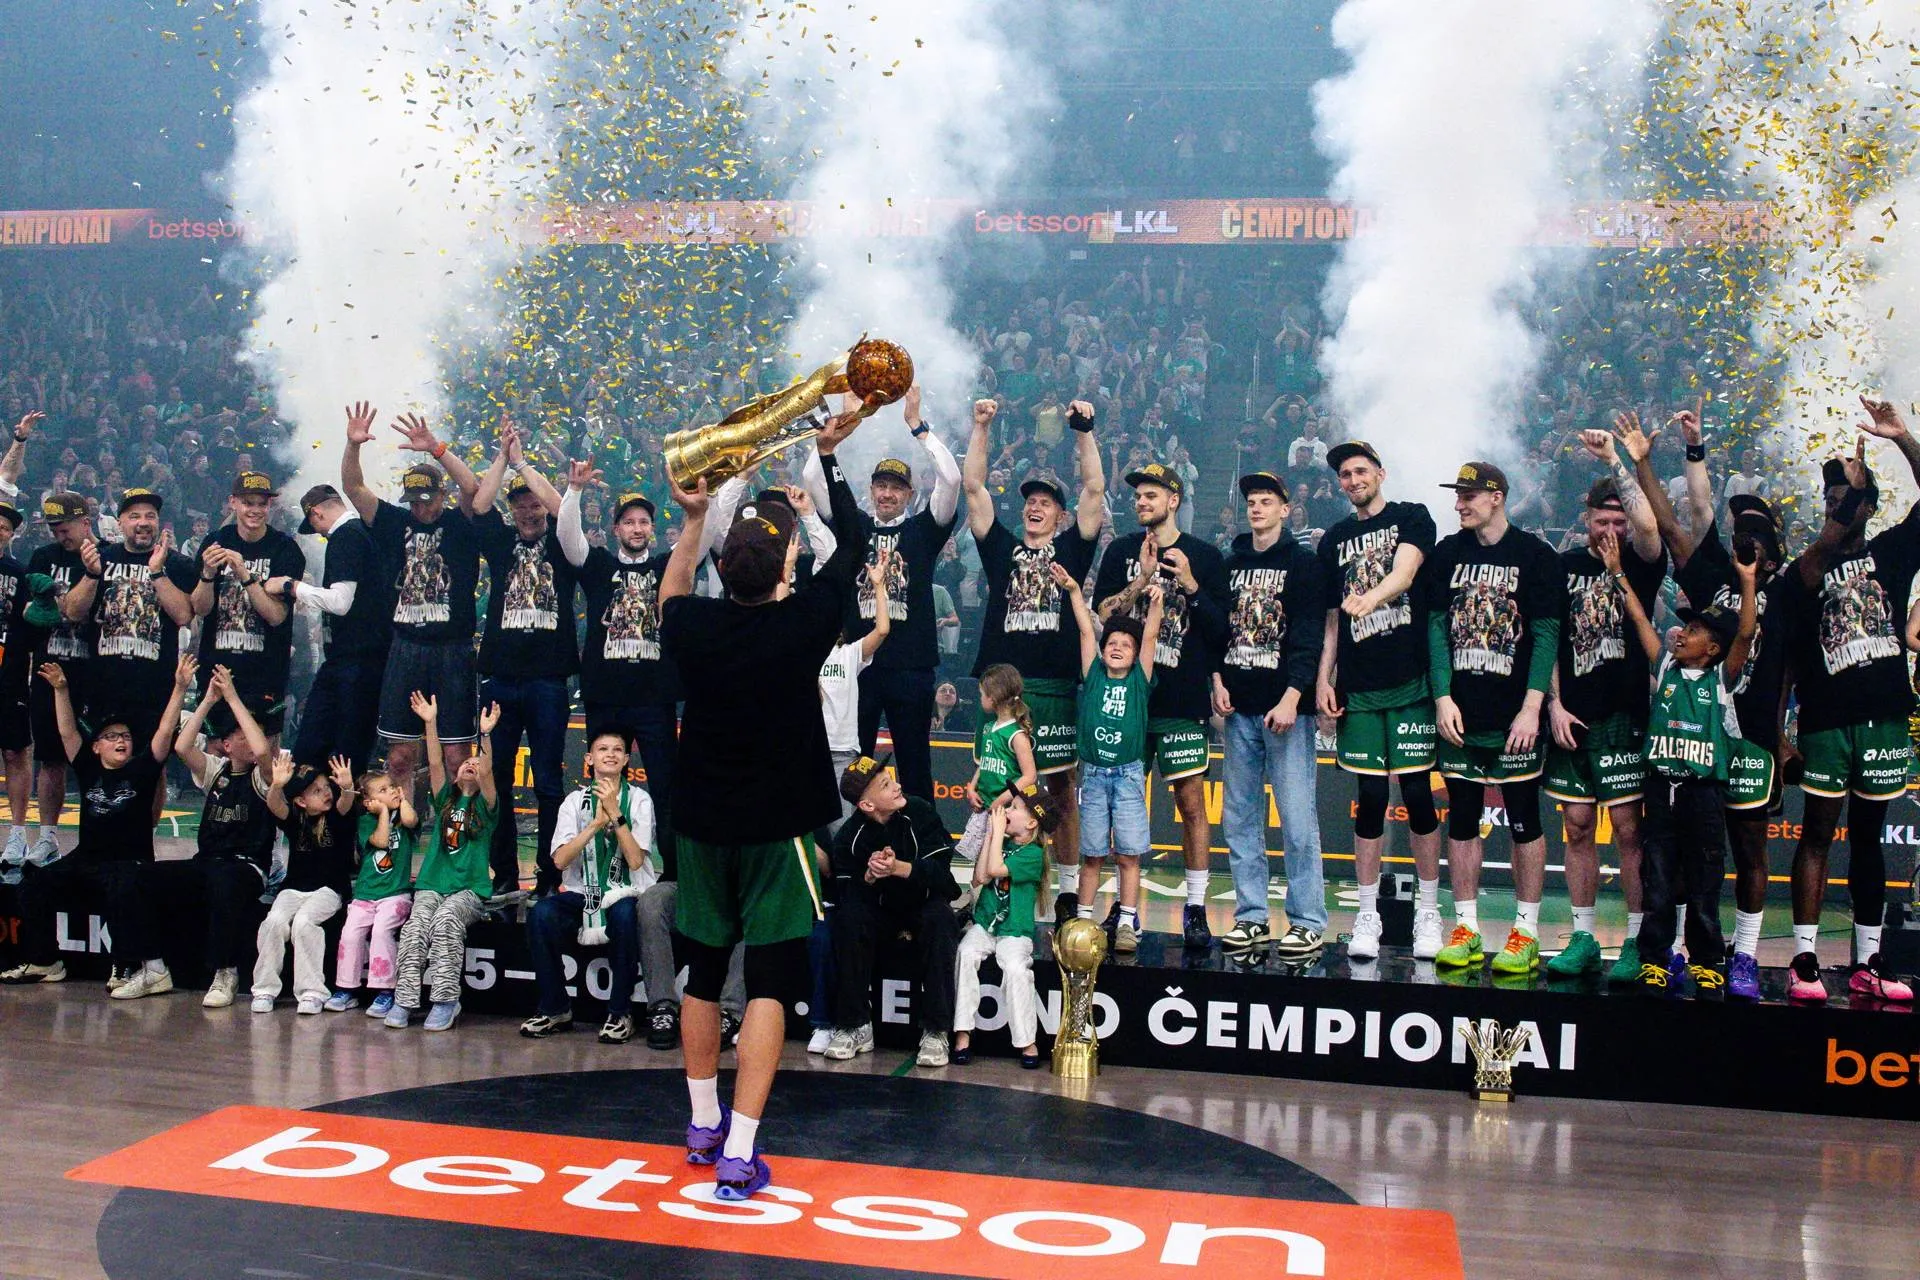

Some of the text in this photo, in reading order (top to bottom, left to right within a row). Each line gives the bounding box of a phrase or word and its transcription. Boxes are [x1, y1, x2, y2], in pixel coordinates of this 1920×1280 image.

[976, 211, 1105, 233] betsson
[1115, 211, 1178, 233] LKL
[98, 637, 160, 661] CHAMPIONS
[603, 639, 661, 661] CHAMPIONS
[1826, 633, 1902, 676] CHAMPIONS
[1049, 724, 1077, 738] Artea
[1094, 726, 1122, 745] Go3
[1409, 722, 1436, 735] Artea
[1730, 756, 1764, 769] Artea
[1877, 747, 1909, 762] Artea
[1872, 775, 1902, 785] KAUNAS
[1880, 825, 1920, 846] KL
[1147, 986, 1577, 1071] ČEMPIONAI
[207, 1126, 1328, 1278] betsson
